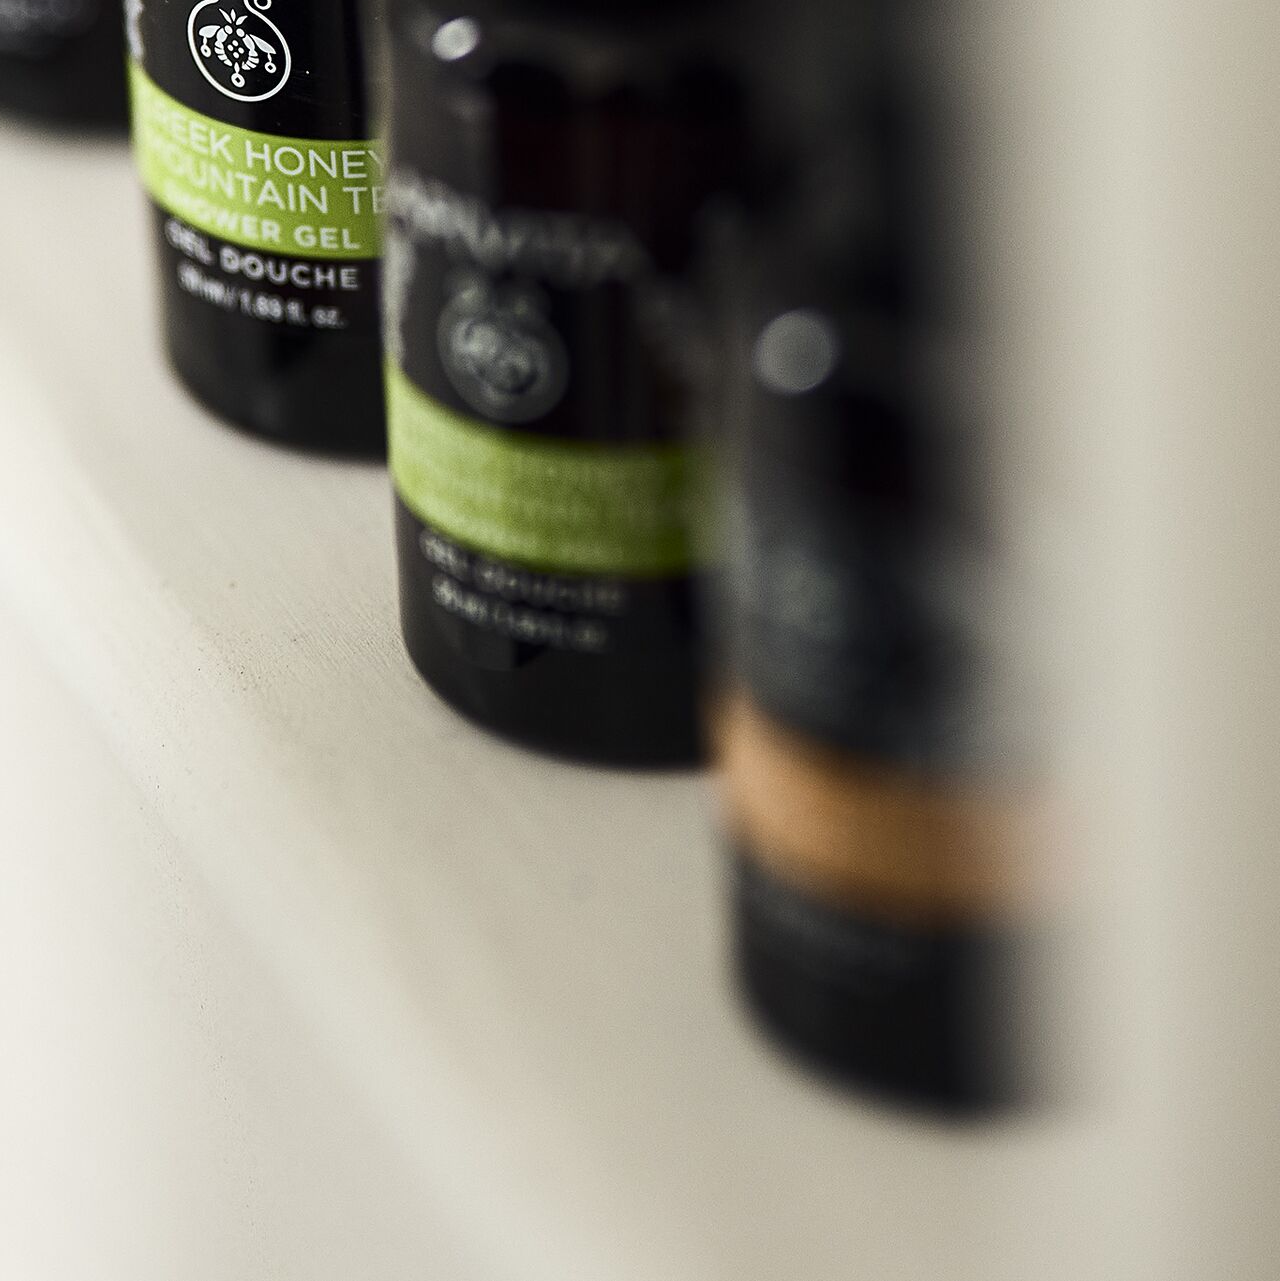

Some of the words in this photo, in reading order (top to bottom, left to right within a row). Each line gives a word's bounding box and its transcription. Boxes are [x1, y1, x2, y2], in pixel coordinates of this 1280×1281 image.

[152, 136, 328, 215] OUNTAIN
[342, 185, 386, 215] TE
[293, 224, 362, 250] GEL
[219, 246, 359, 291] DOUCHE
